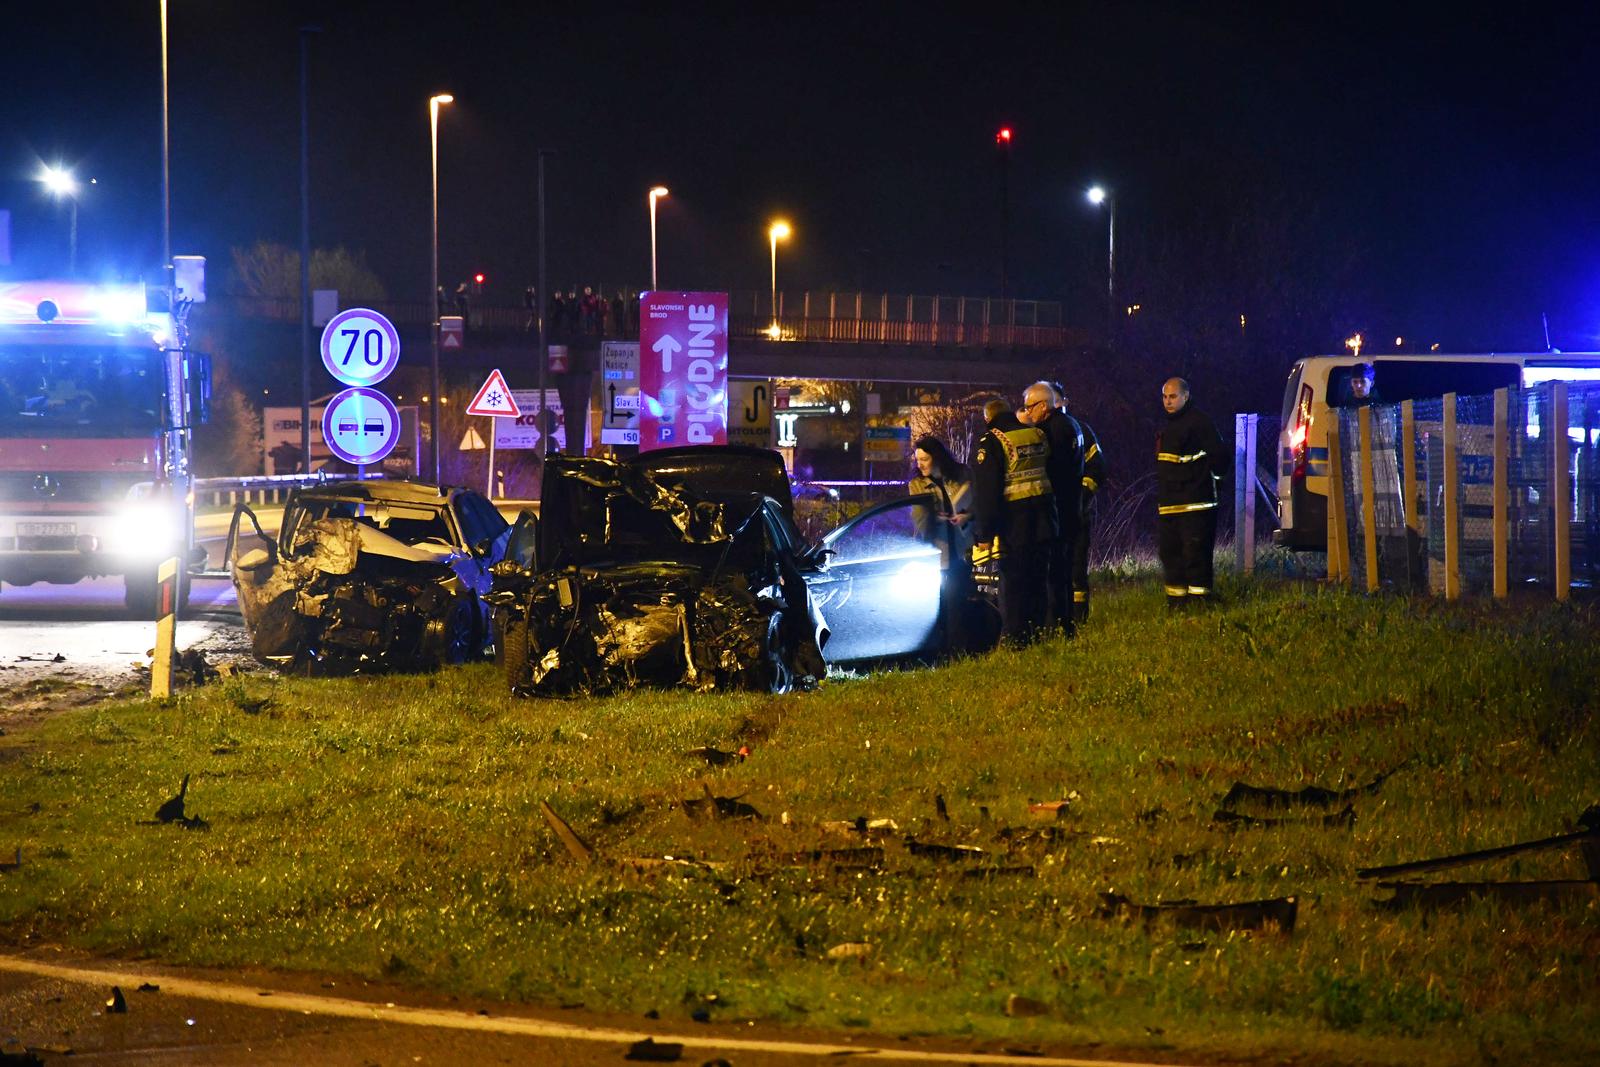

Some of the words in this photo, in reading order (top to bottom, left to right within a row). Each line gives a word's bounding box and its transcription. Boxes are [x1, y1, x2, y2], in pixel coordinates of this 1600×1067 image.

[341, 329, 383, 366] 70
[687, 304, 716, 444] PLODINE
[624, 432, 638, 442] 150
